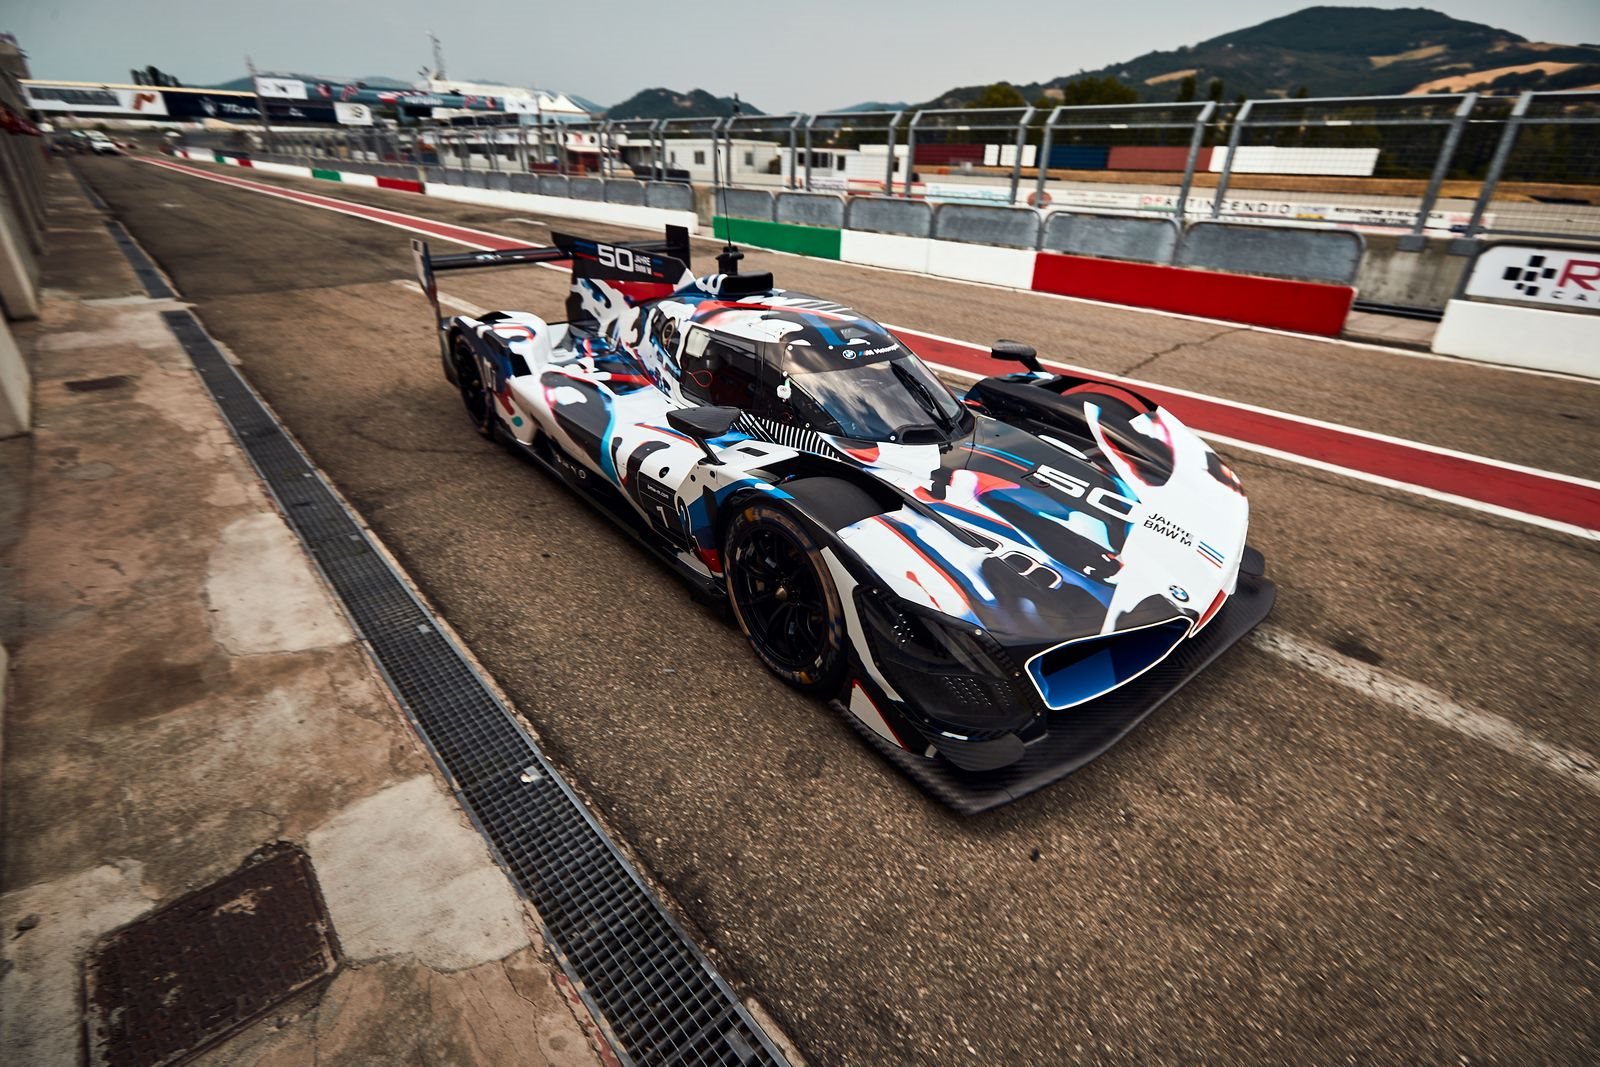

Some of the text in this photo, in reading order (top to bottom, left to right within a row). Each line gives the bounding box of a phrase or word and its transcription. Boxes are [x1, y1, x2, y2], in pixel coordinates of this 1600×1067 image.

[597, 244, 634, 272] 50
[634, 254, 652, 267] JAHRE
[1551, 291, 1600, 303] CA
[1033, 464, 1137, 524] 50
[1143, 519, 1192, 547] BMW M
[1148, 513, 1194, 540] JAHRE
